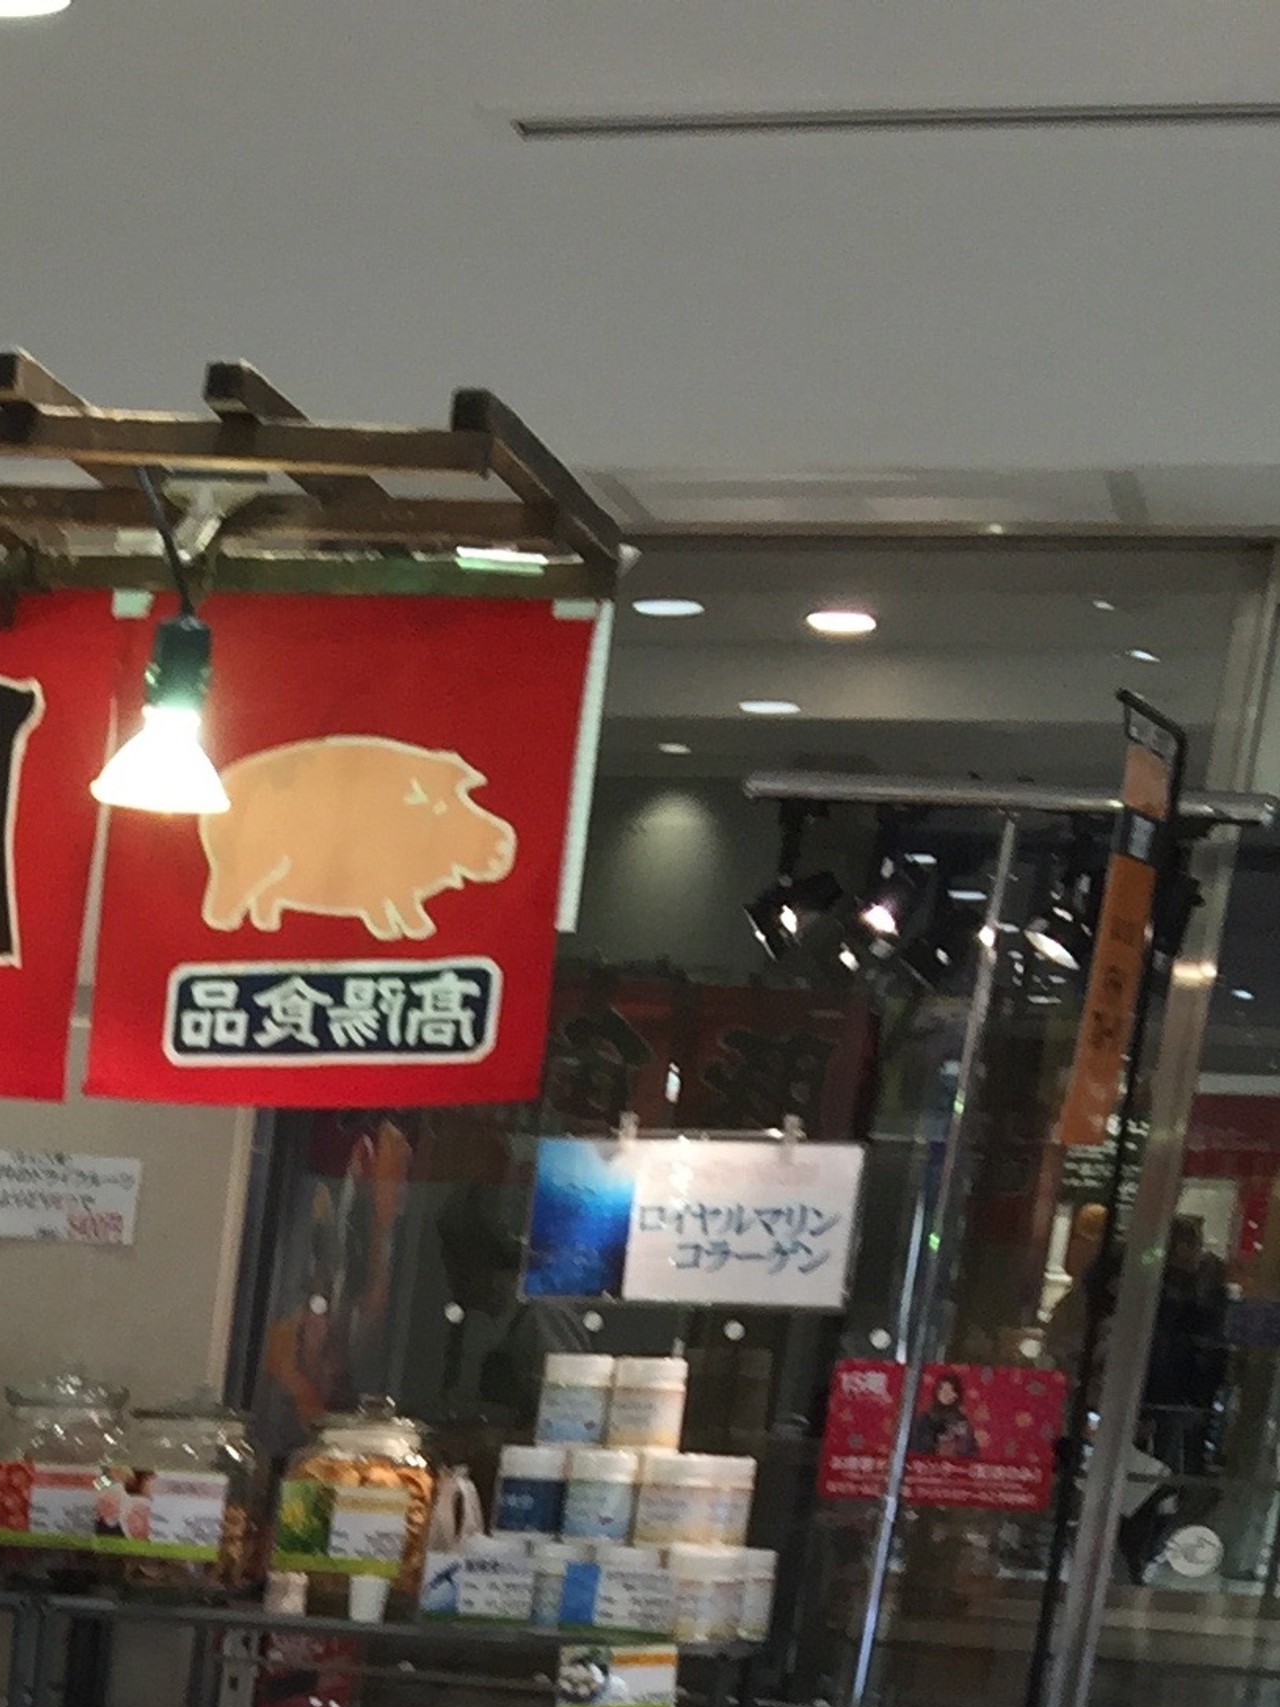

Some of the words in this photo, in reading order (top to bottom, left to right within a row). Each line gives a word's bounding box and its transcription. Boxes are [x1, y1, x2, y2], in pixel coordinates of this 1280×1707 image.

[638, 1202, 842, 1237] ロイヤルマリン
[674, 1238, 832, 1275] コラーゲン
